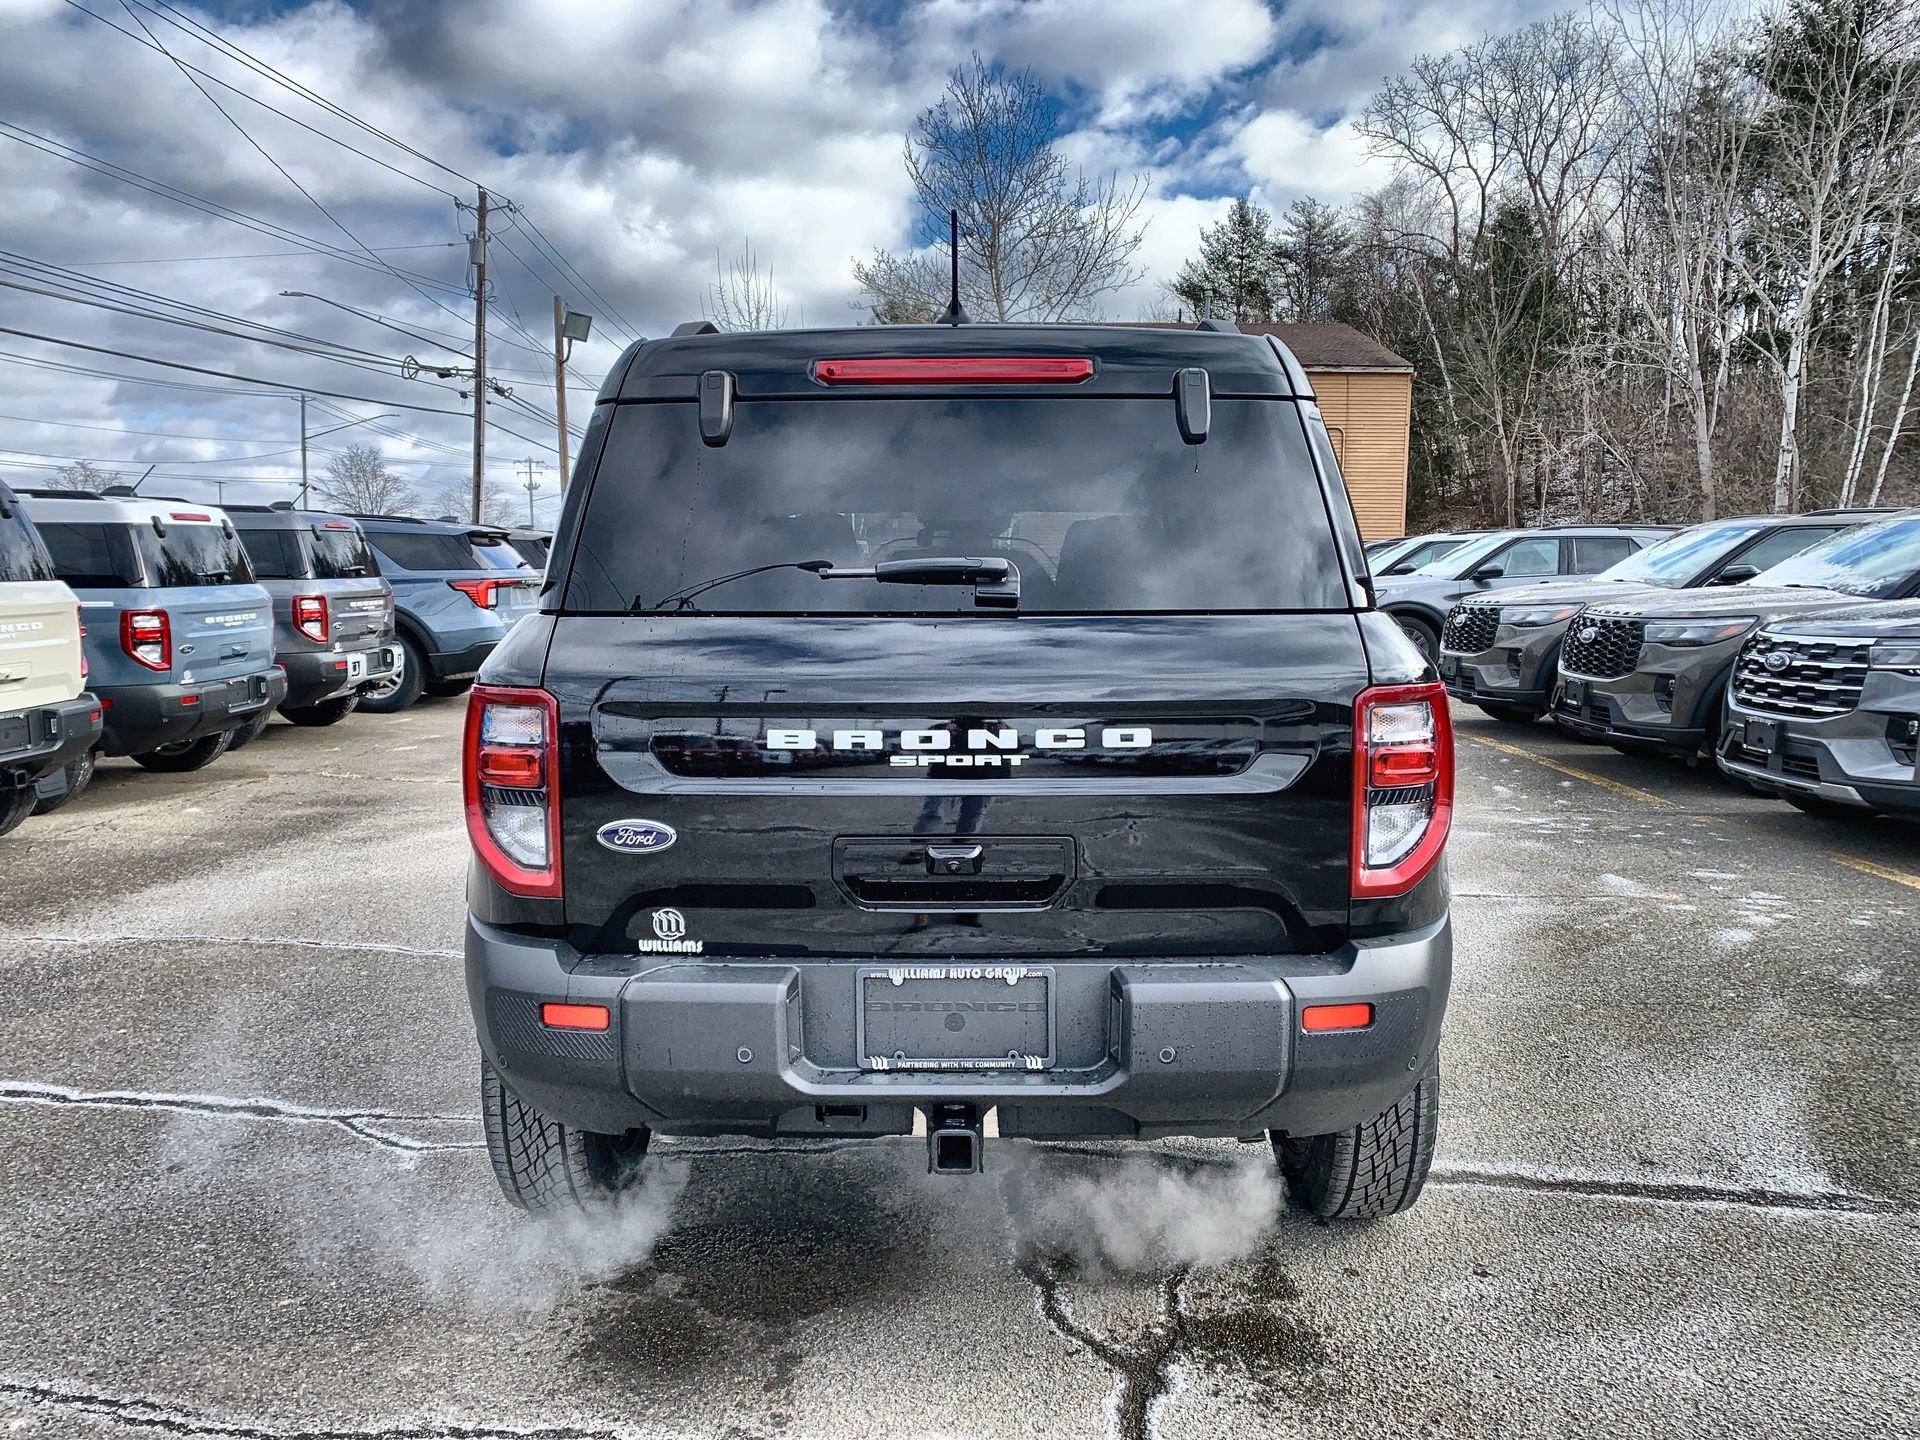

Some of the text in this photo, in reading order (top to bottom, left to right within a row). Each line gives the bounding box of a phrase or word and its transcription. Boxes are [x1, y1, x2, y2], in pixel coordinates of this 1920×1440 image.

[766, 728, 1152, 749] BRONCO
[889, 754, 1030, 767] SPORT
[614, 826, 657, 846] Ford
[638, 939, 703, 953] WILLIAMS
[949, 968, 981, 979] AUTO
[865, 1002, 1047, 1012] BRONCO
[897, 1061, 1016, 1069] PARTNERING WITH THE COMMUNITY
